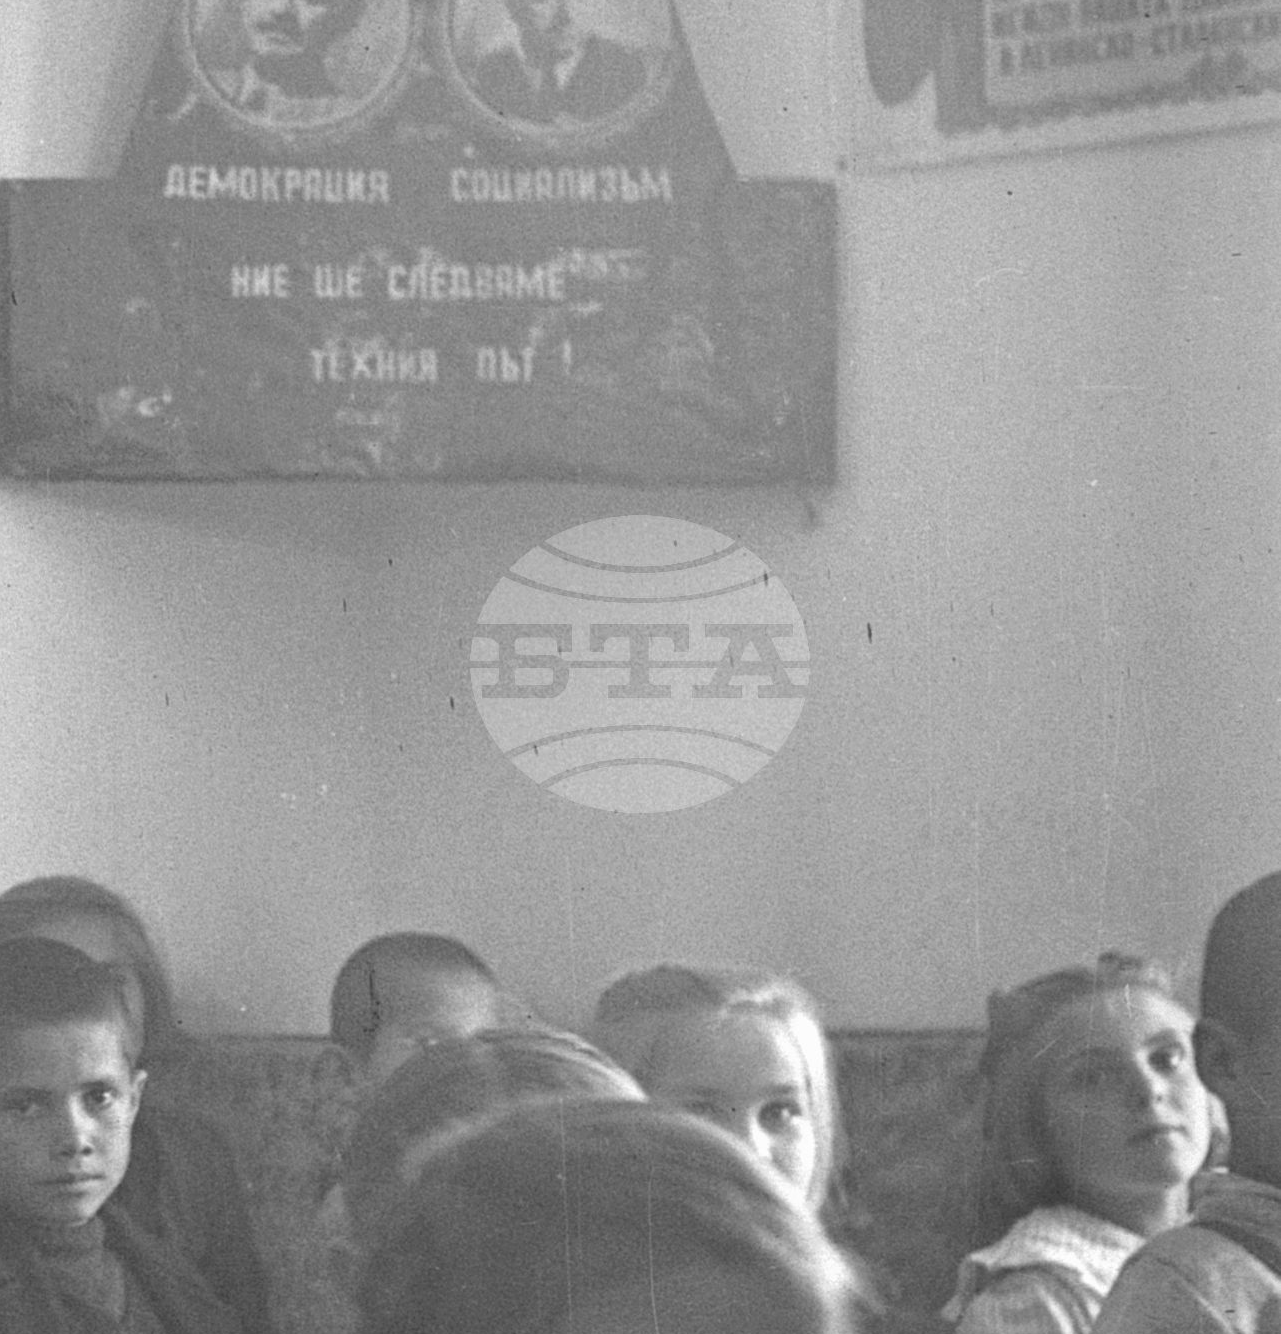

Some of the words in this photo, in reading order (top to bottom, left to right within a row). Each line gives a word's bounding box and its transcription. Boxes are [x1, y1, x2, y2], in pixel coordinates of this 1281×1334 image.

[163, 165, 390, 204] ДЕМОКРАЦИЯ
[231, 265, 288, 298] НИЕ
[387, 265, 565, 300] СЛЕДВАМЕ
[310, 347, 438, 382] ТЕХНИЯ
